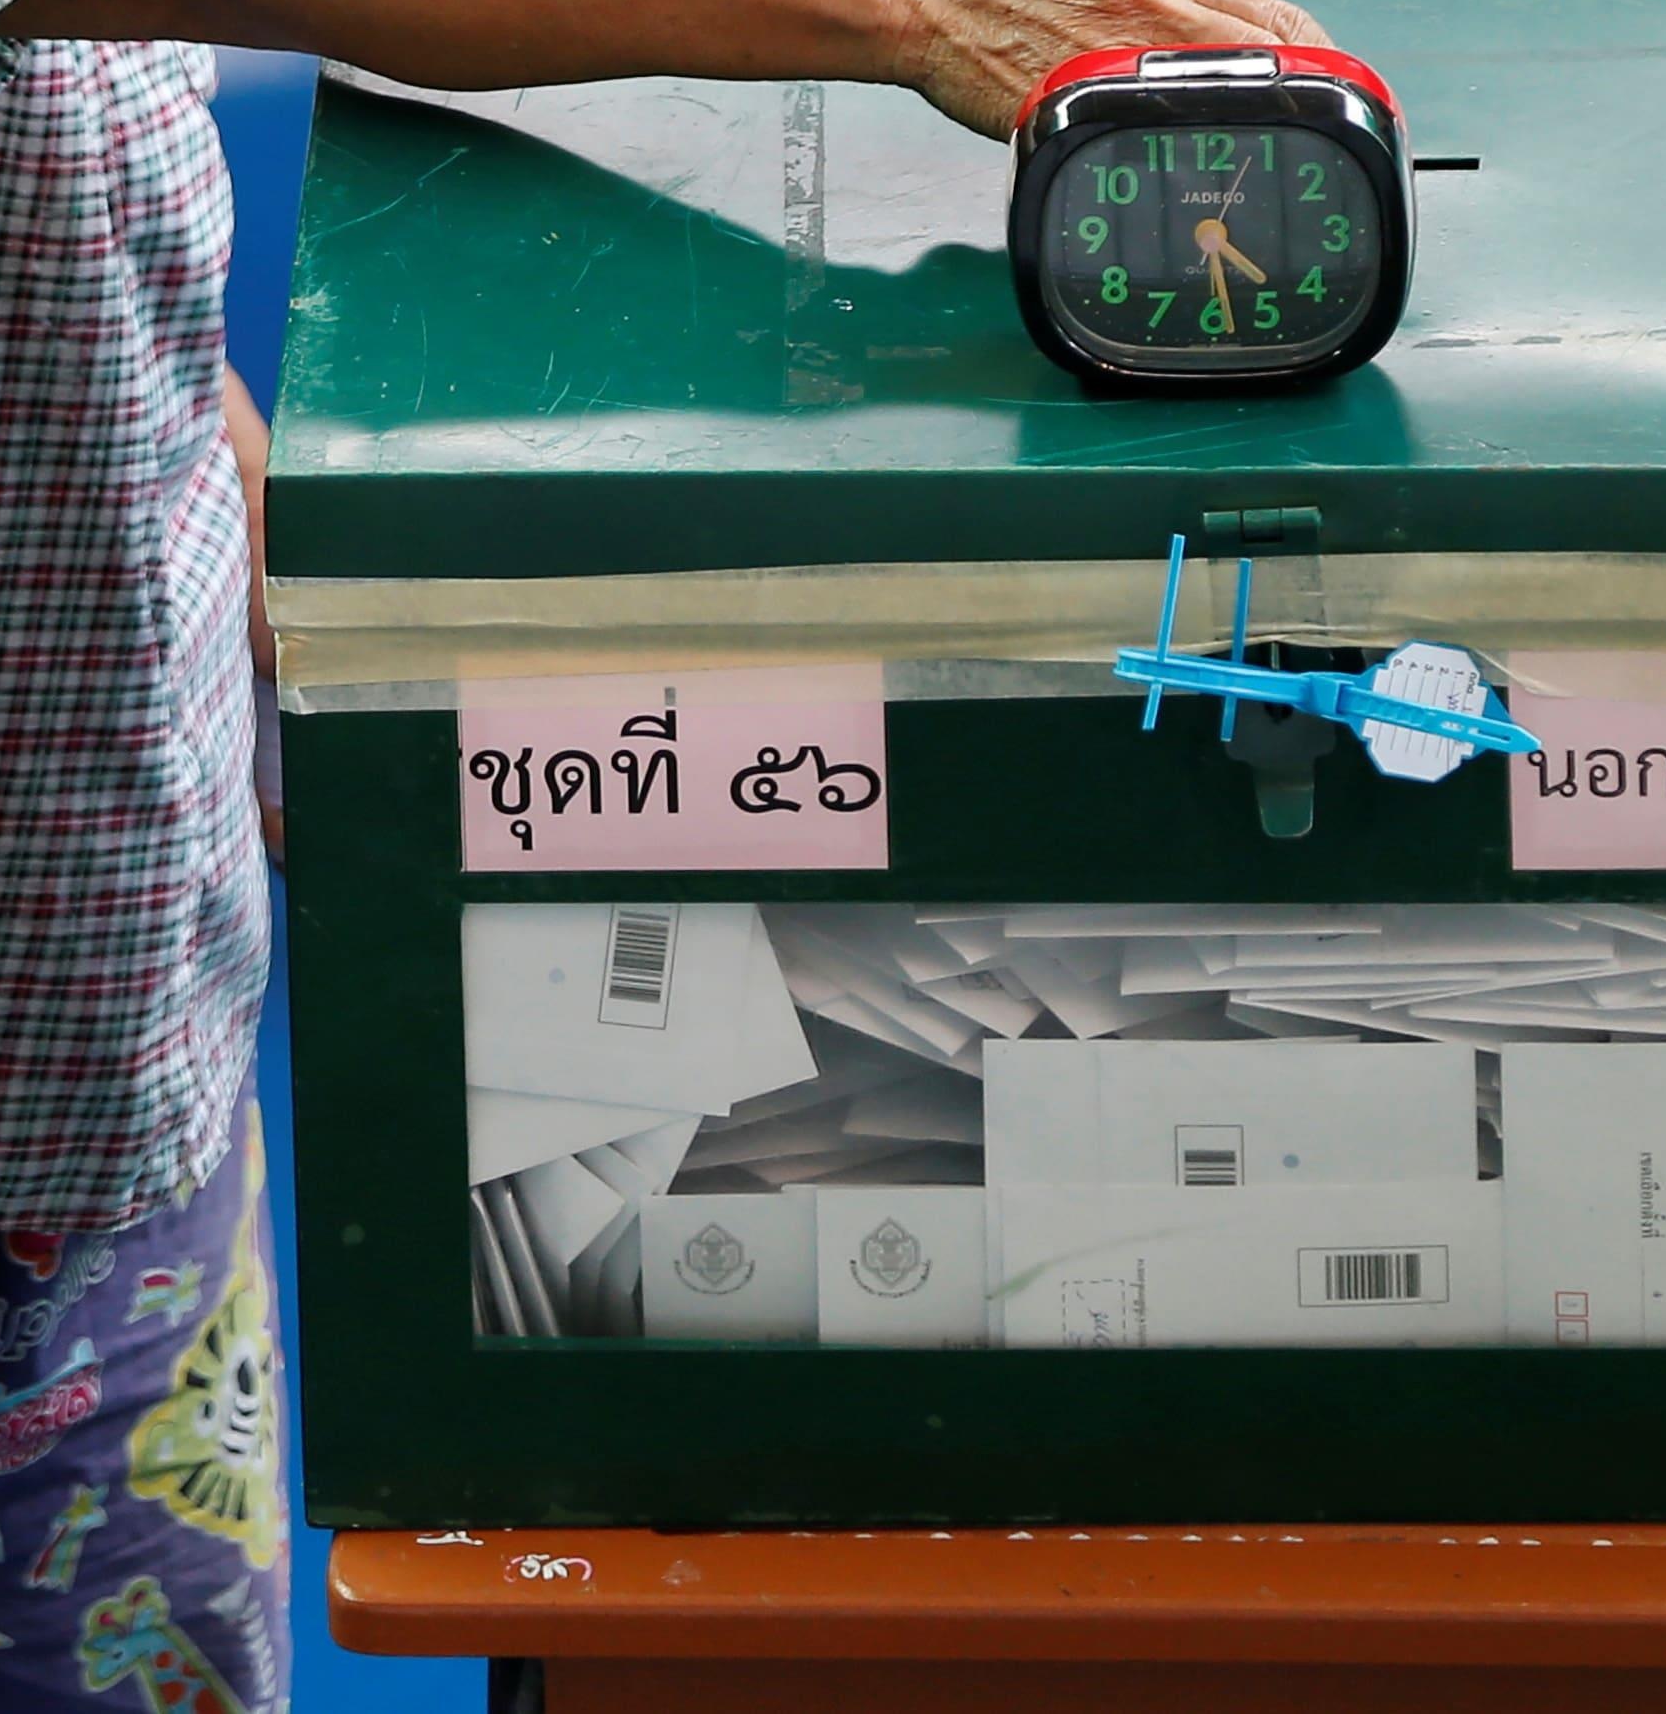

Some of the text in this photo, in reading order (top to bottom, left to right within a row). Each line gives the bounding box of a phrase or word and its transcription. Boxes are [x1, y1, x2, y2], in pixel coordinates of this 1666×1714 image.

[1143, 134, 1175, 172] 11
[1191, 134, 1236, 171] 12
[1259, 134, 1275, 171] 1
[1092, 165, 1139, 205] 10
[1298, 162, 1326, 201] 2
[1078, 216, 1109, 254] 9
[1322, 215, 1350, 253] 3
[1101, 266, 1128, 304] 8
[1296, 266, 1328, 303] 4
[1148, 292, 1177, 329] 7
[1199, 296, 1228, 334] 6
[1254, 292, 1281, 329] 5
[469, 687, 882, 851] ชุดที่ ๕๖
